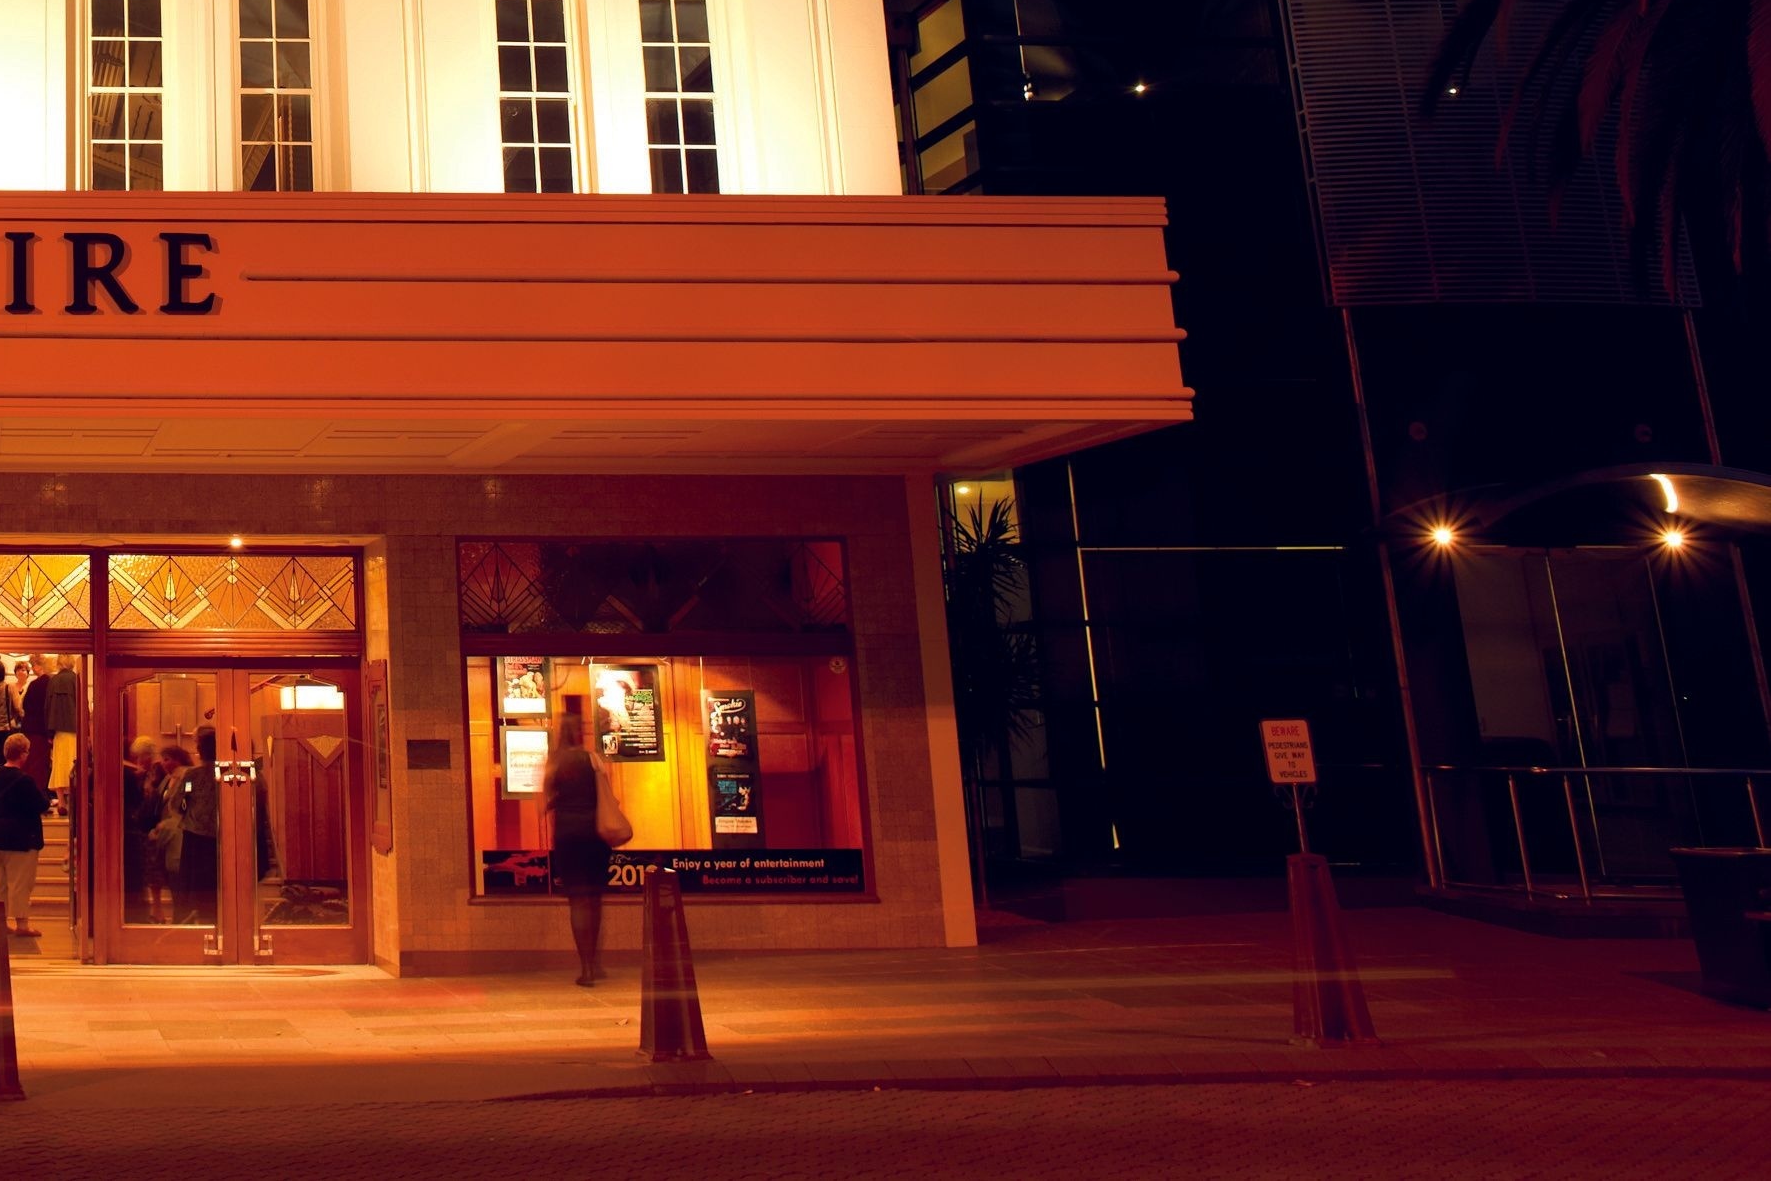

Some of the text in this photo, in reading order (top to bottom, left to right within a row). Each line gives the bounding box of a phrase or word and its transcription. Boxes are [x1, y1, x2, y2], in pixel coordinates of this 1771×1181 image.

[1271, 726, 1300, 736] BEWARE
[1288, 761, 1296, 769] TO
[672, 857, 825, 871] Enjoy a year of entertainment
[703, 874, 859, 886] Become a subscriber and save!
